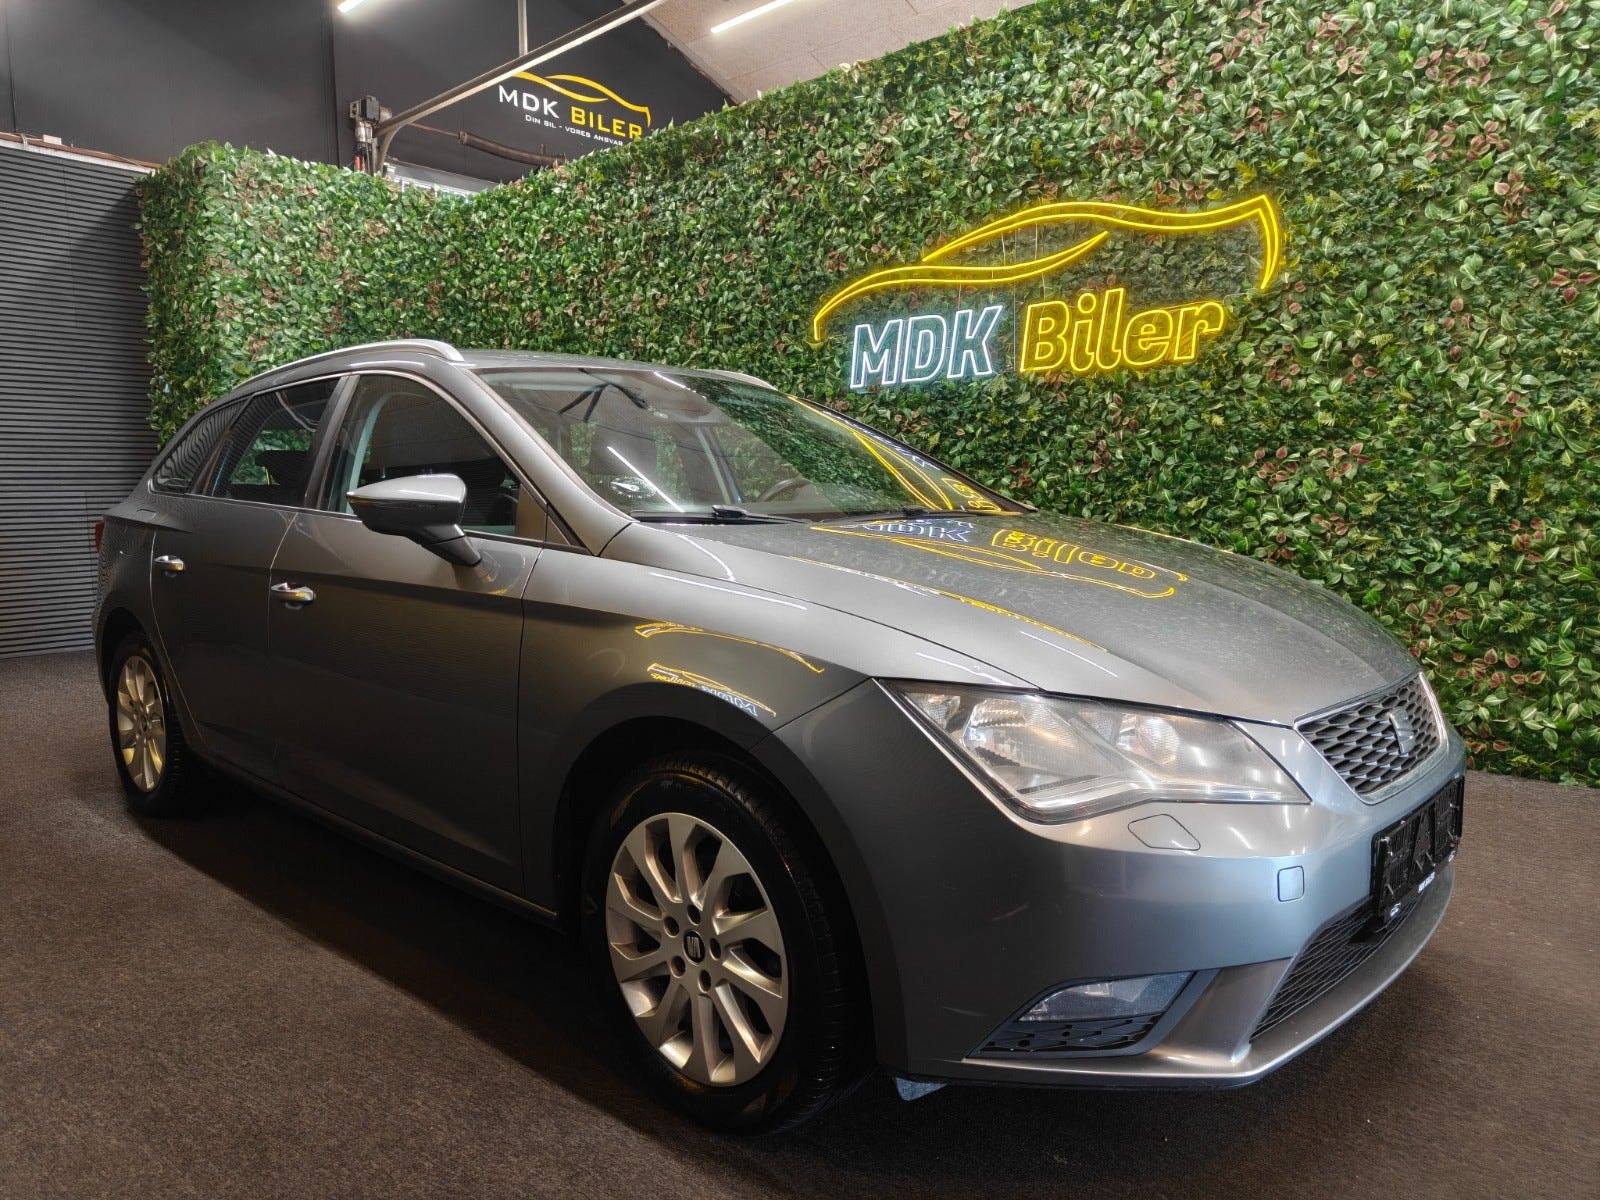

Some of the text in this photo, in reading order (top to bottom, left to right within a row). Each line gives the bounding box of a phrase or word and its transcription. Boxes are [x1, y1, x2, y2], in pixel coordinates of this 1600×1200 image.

[498, 85, 642, 139] MDK BILER
[850, 288, 1225, 389] MDK Biler
